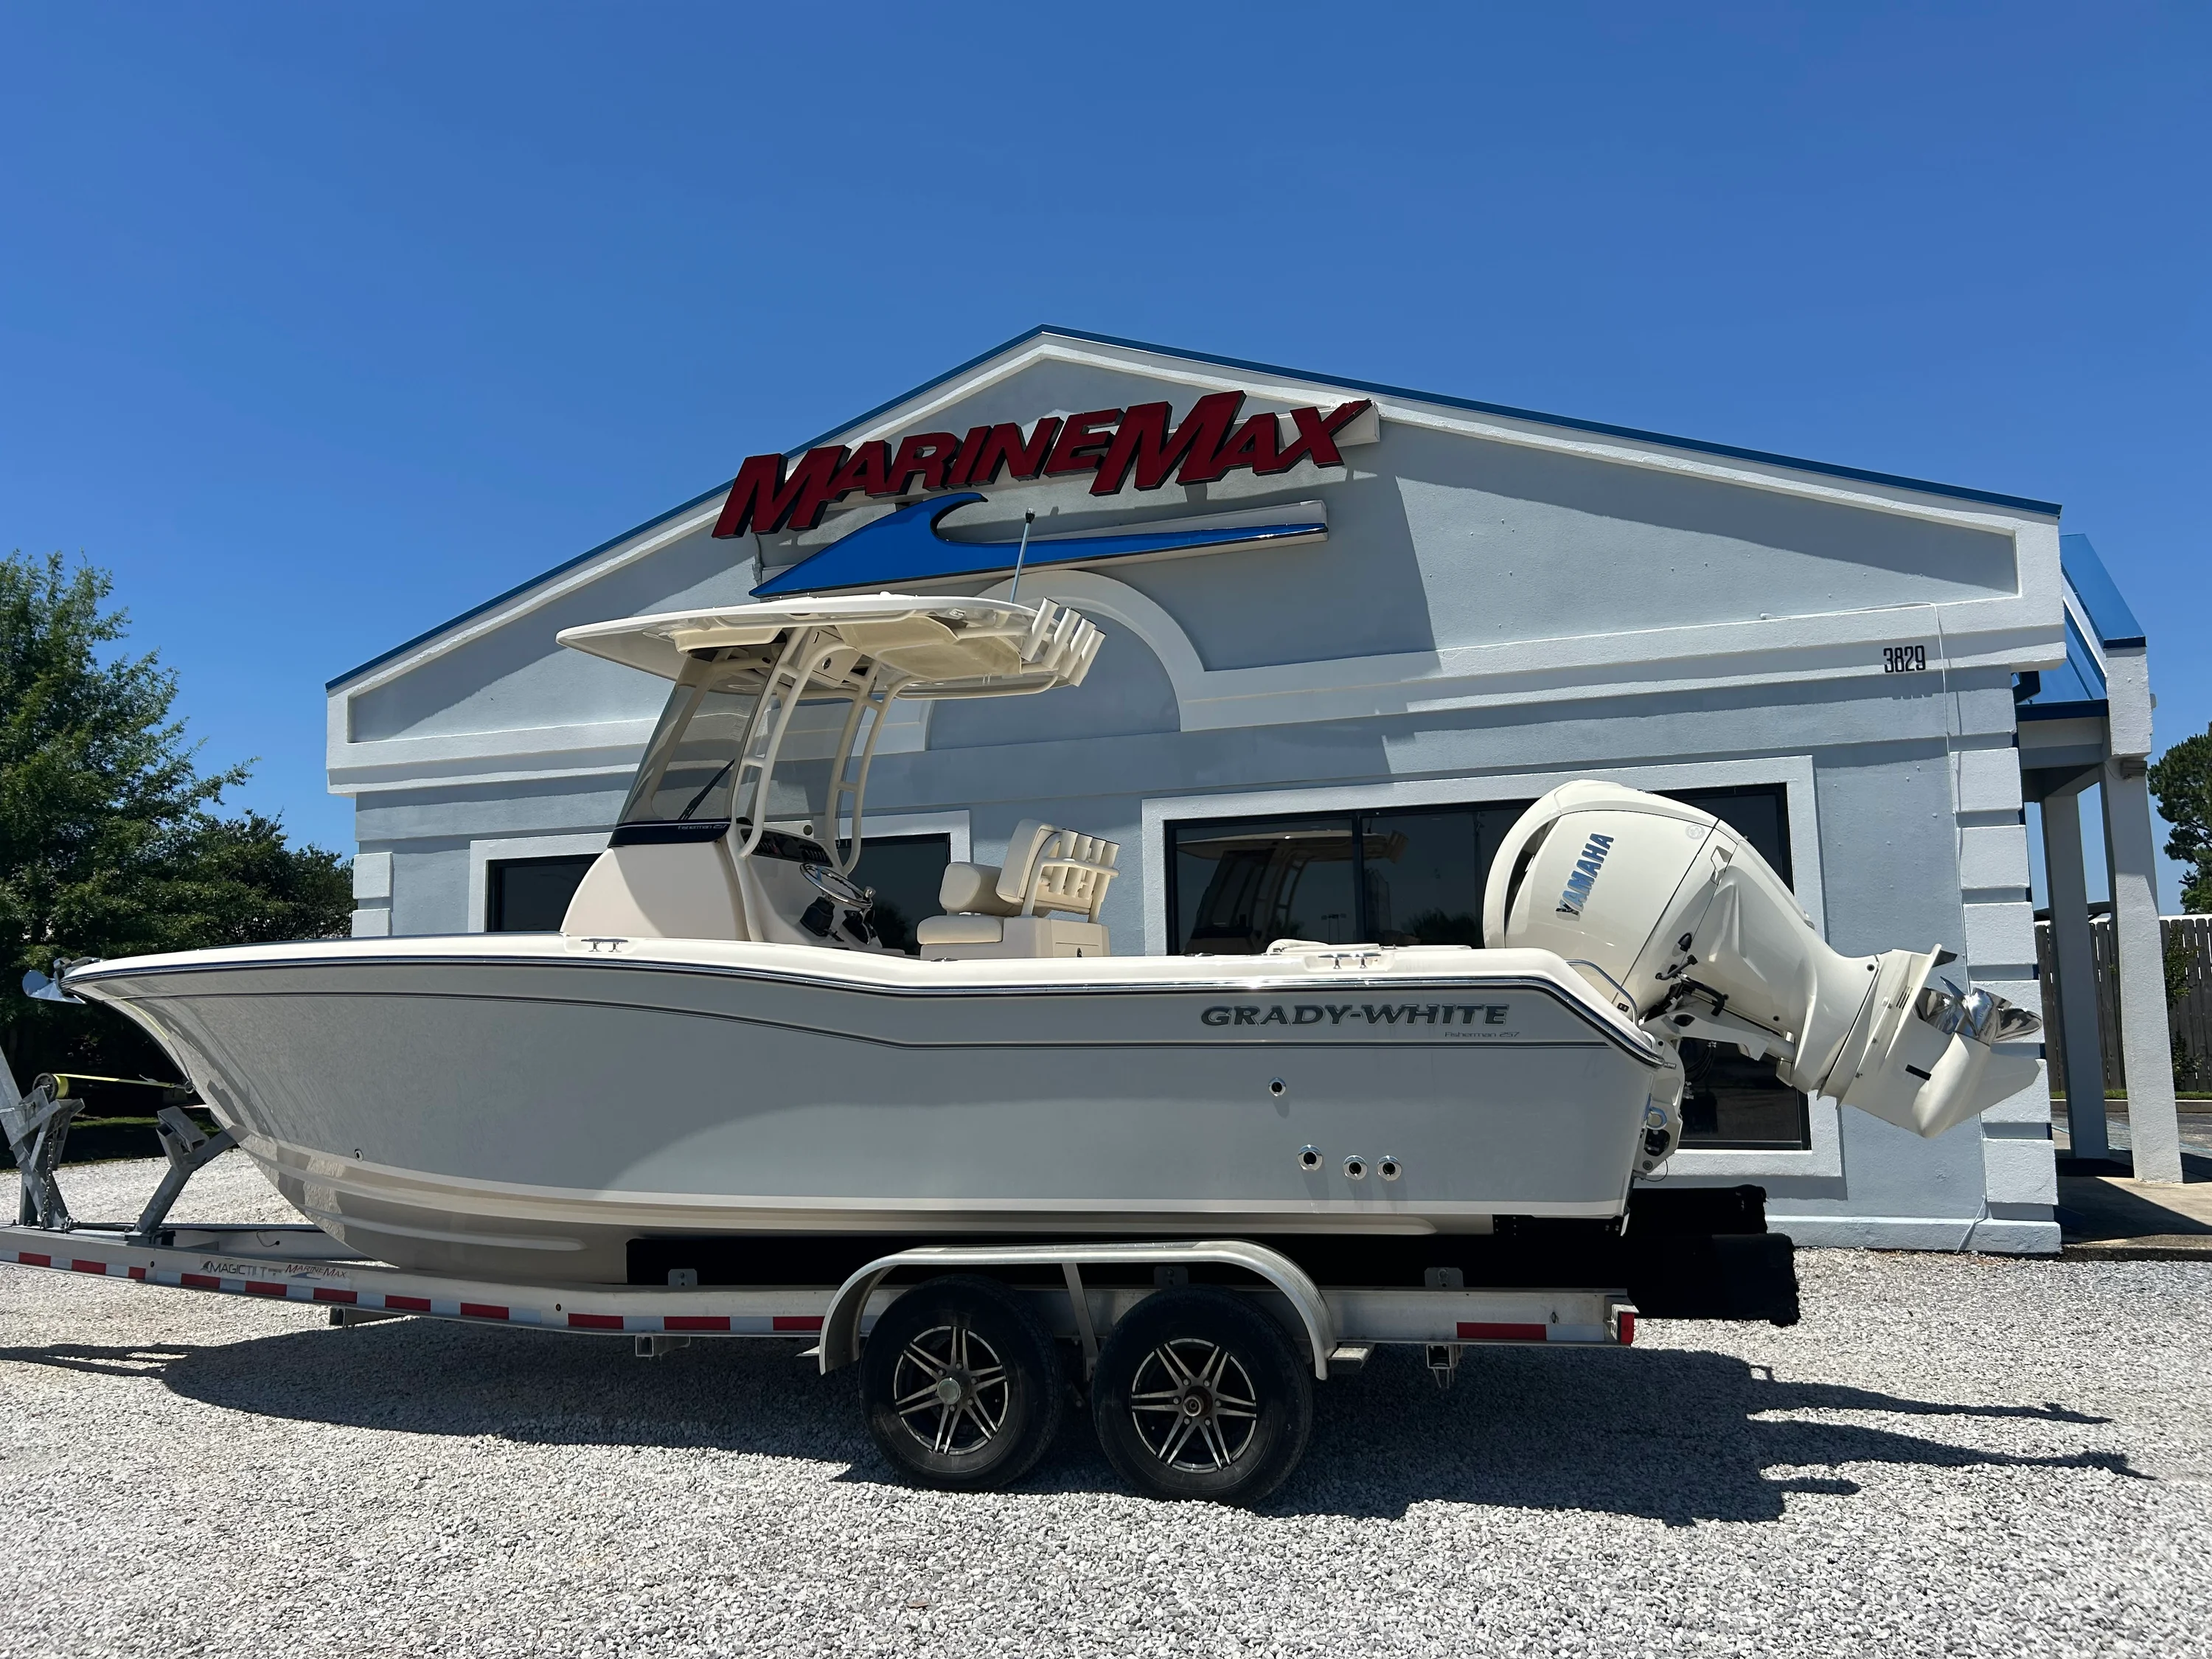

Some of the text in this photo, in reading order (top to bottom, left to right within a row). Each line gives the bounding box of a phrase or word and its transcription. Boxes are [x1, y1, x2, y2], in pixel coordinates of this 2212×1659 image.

[1882, 644, 1926, 672] 3829
[1555, 832, 1615, 919] YAMAHA
[1200, 1003, 1510, 1027] GRADY-WHITE
